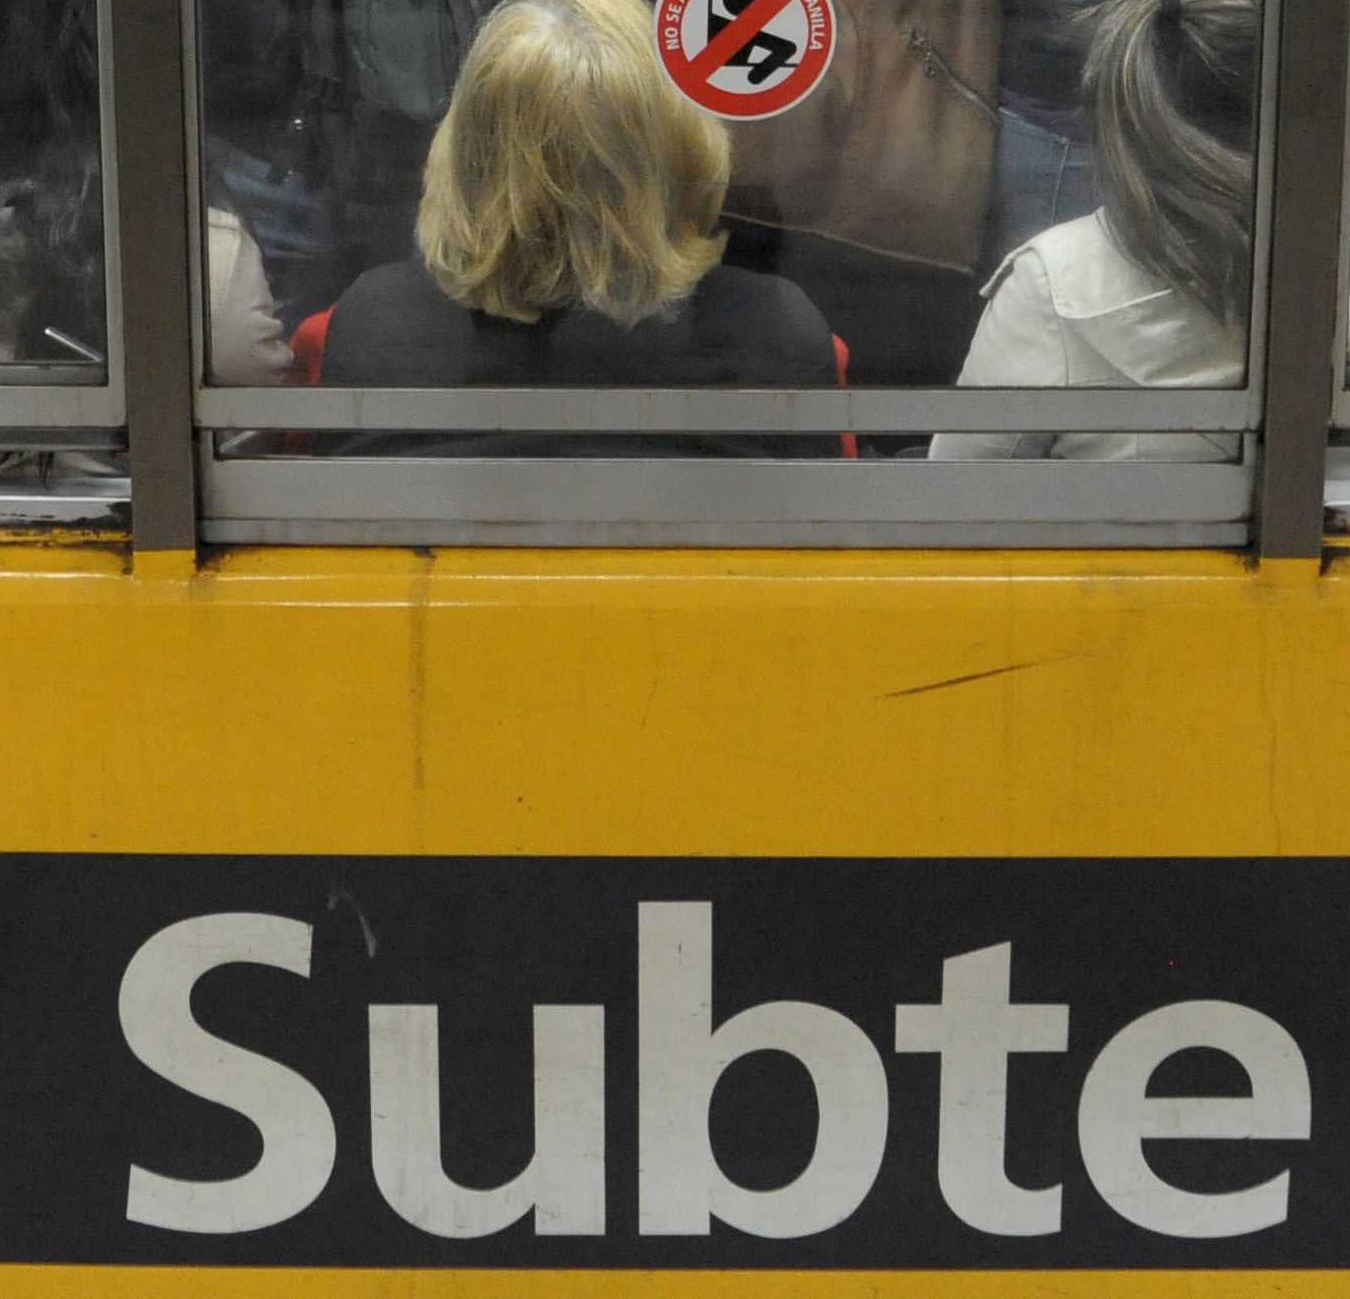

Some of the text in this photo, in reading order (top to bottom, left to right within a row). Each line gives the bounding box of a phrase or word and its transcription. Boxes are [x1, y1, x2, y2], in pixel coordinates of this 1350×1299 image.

[666, 4, 682, 23] SE
[665, 27, 680, 50] NO
[118, 900, 1313, 1239] Subte
